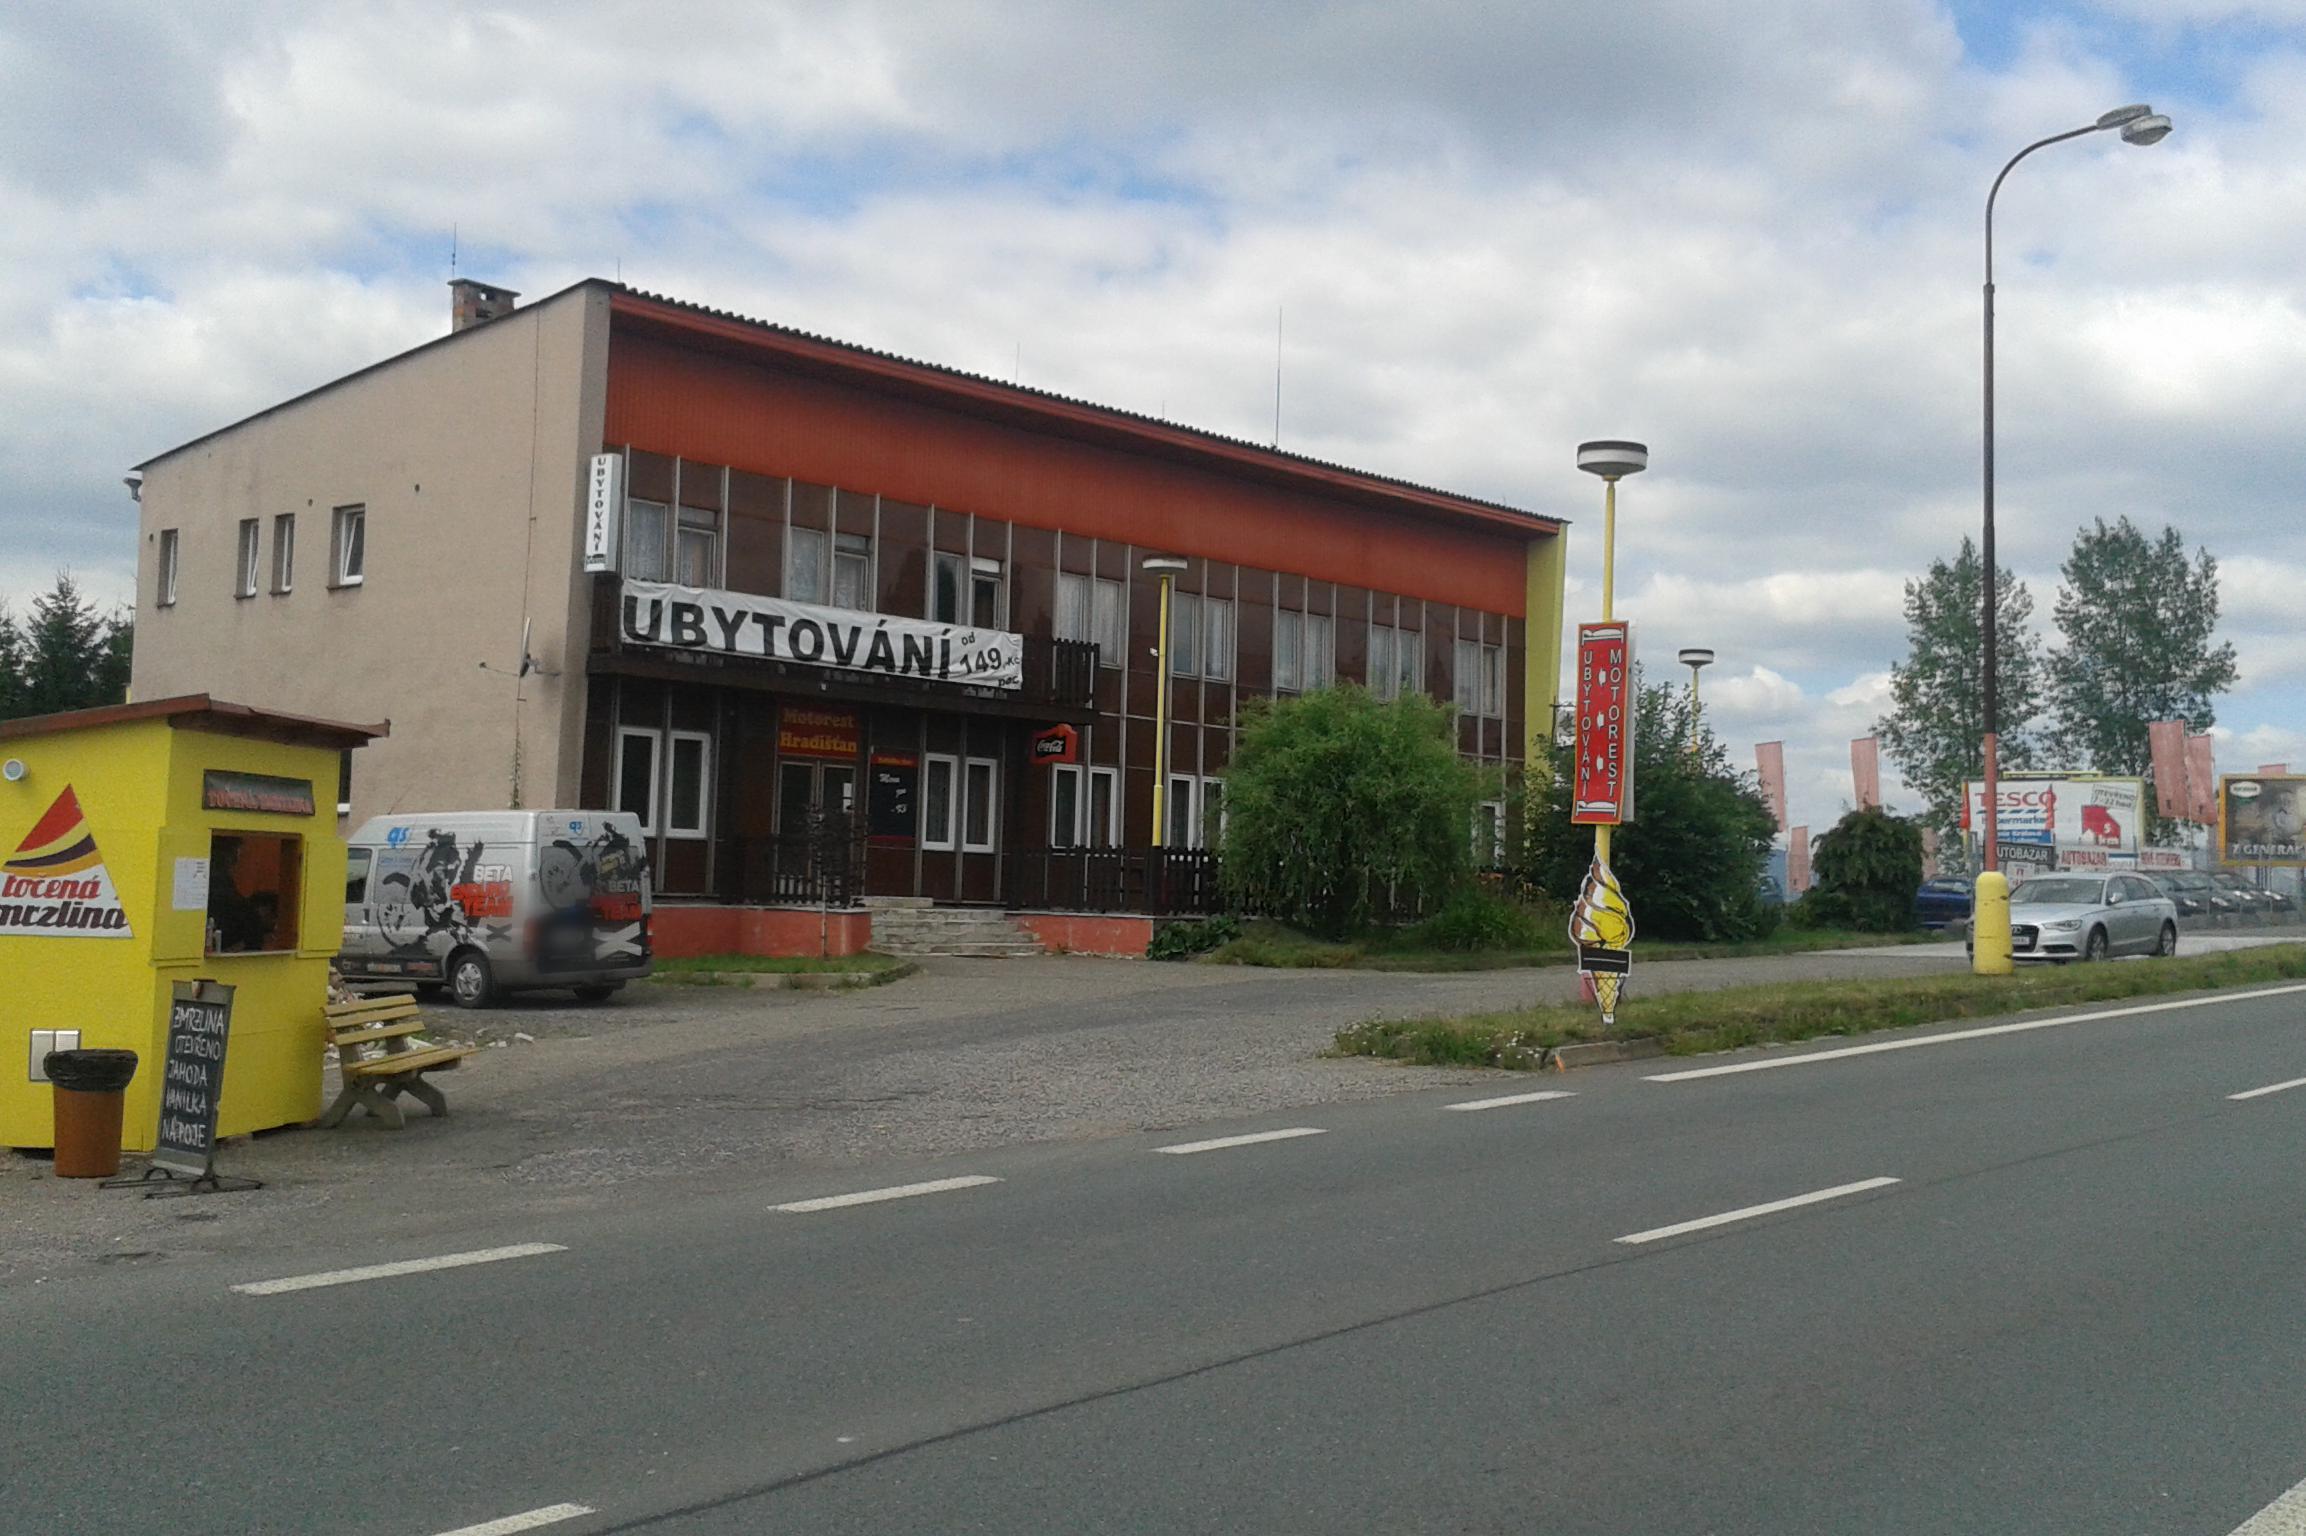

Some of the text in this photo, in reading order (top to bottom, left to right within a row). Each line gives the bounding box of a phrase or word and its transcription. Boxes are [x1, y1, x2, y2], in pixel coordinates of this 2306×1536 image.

[624, 595, 951, 680] UBYTOVÁNÍ
[961, 631, 976, 646] od
[784, 708, 855, 728] Motorest
[1607, 649, 1622, 797] MOTOREST
[1995, 845, 2048, 862] UTOBAZAR
[473, 864, 513, 883] BETA
[608, 879, 640, 892] BETA
[2, 875, 101, 899] točená
[173, 1006, 225, 1035] ZMRZLINA
[168, 1059, 208, 1087] JAHODA
[165, 1086, 207, 1117] VANILKA
[161, 1115, 206, 1148] NÁPOJE
